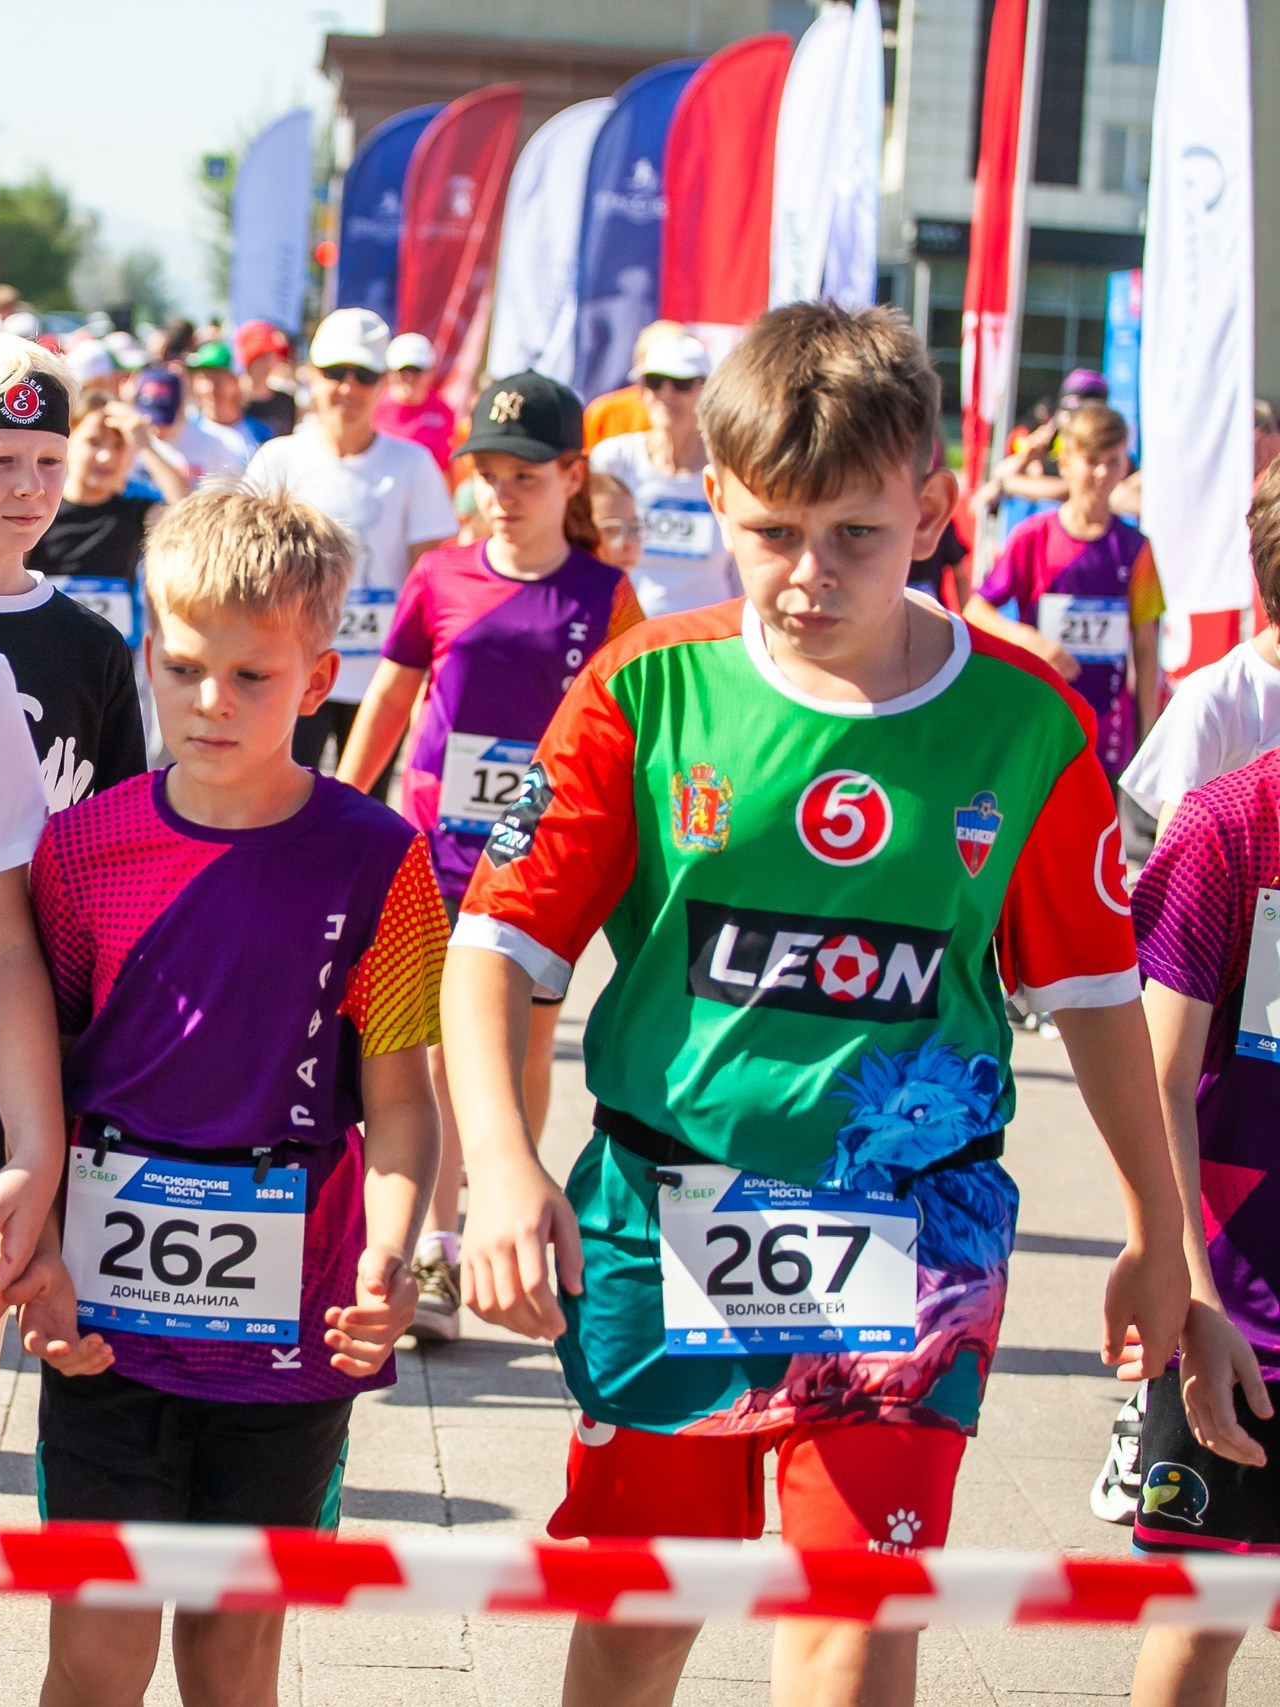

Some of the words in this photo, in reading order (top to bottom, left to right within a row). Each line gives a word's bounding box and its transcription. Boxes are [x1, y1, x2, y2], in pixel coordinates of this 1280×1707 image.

[1061, 615, 1110, 643] 217
[709, 923, 944, 1004] LEON
[89, 1169, 117, 1182] СБЕР
[144, 1172, 229, 1190] КРАСНОЯРСКИЕ
[165, 1185, 205, 1198] МОСТЫ
[256, 1188, 283, 1199] 1628
[685, 1188, 716, 1199] СБЕР
[769, 1188, 812, 1199] МОСТЫ
[99, 1210, 258, 1289] 262
[706, 1224, 871, 1296] 267
[110, 1284, 171, 1303] ДОНЦЕВ
[173, 1292, 239, 1307] ДАНИЛА
[726, 1303, 785, 1316] ВОЛКОВ
[790, 1300, 845, 1315] СЕРГЕЙ
[246, 1322, 276, 1334] 2026
[859, 1330, 892, 1342] 2026
